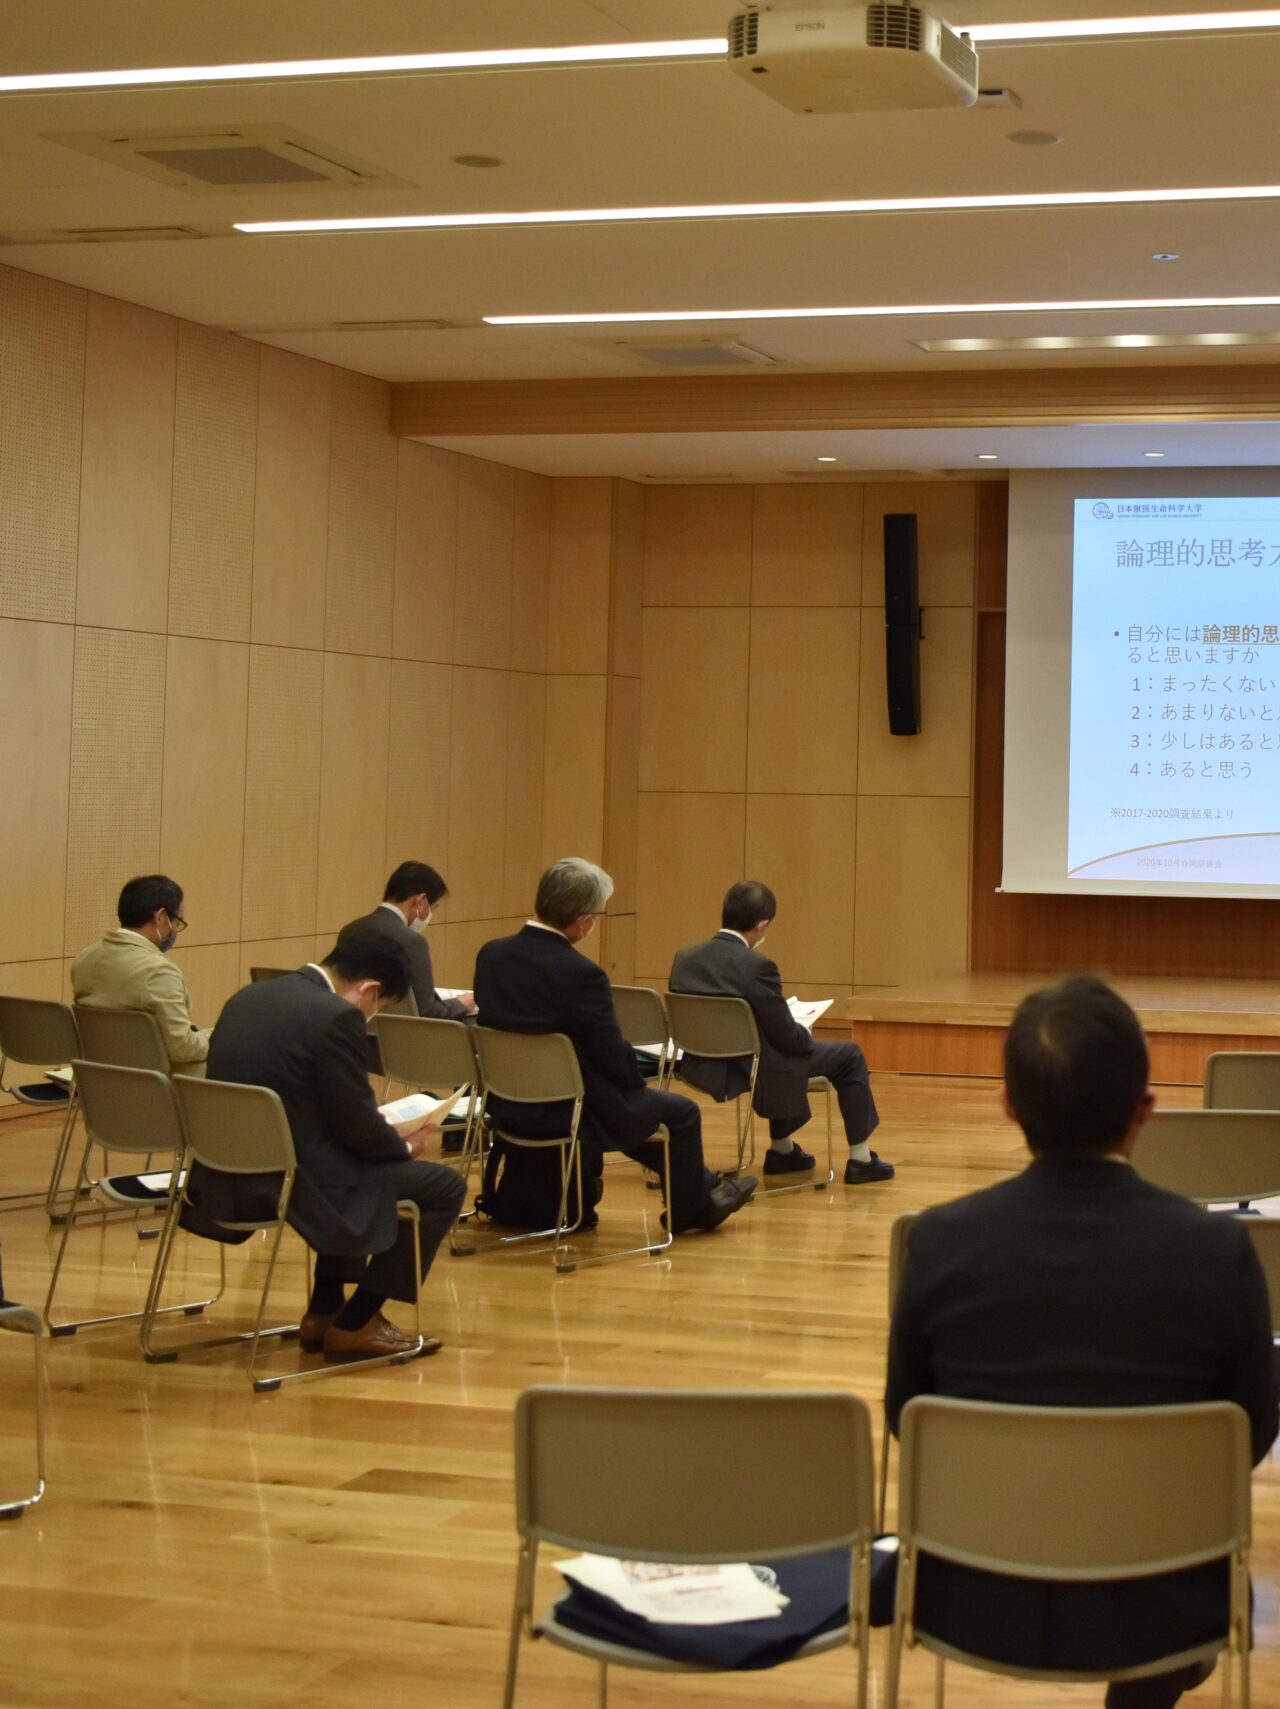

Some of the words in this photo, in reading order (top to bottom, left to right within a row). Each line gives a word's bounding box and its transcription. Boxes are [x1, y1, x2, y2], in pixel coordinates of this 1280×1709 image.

[795, 22, 825, 32] EPSON
[1127, 646, 1259, 664] ると思いますか
